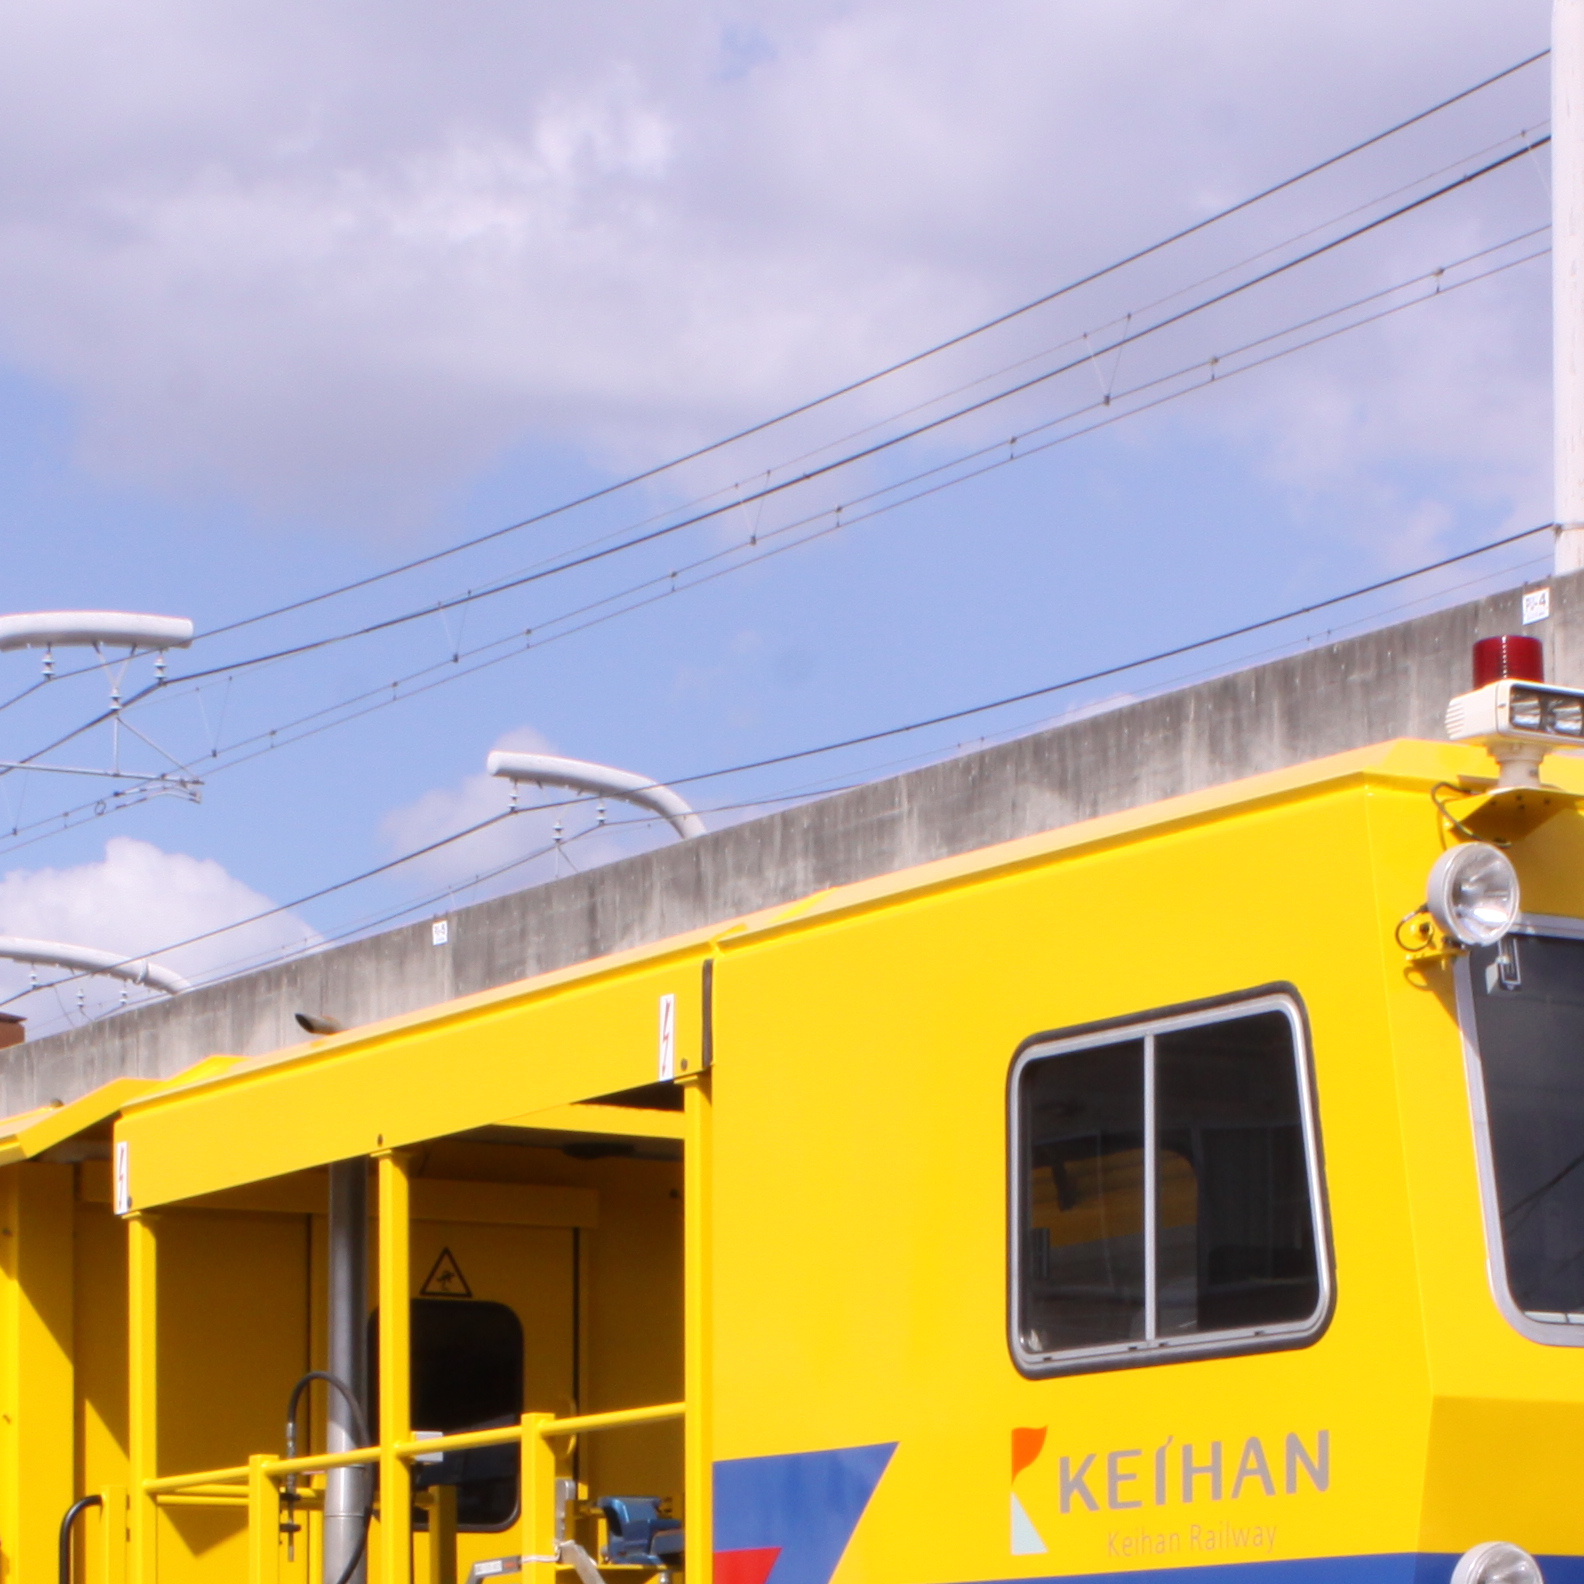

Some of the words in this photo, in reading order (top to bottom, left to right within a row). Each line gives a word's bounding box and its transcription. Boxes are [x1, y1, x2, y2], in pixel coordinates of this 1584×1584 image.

[1058, 1429, 1330, 1514] KEIHAN
[1106, 1526, 1181, 1558] Keihan
[1189, 1520, 1278, 1553] Railway
